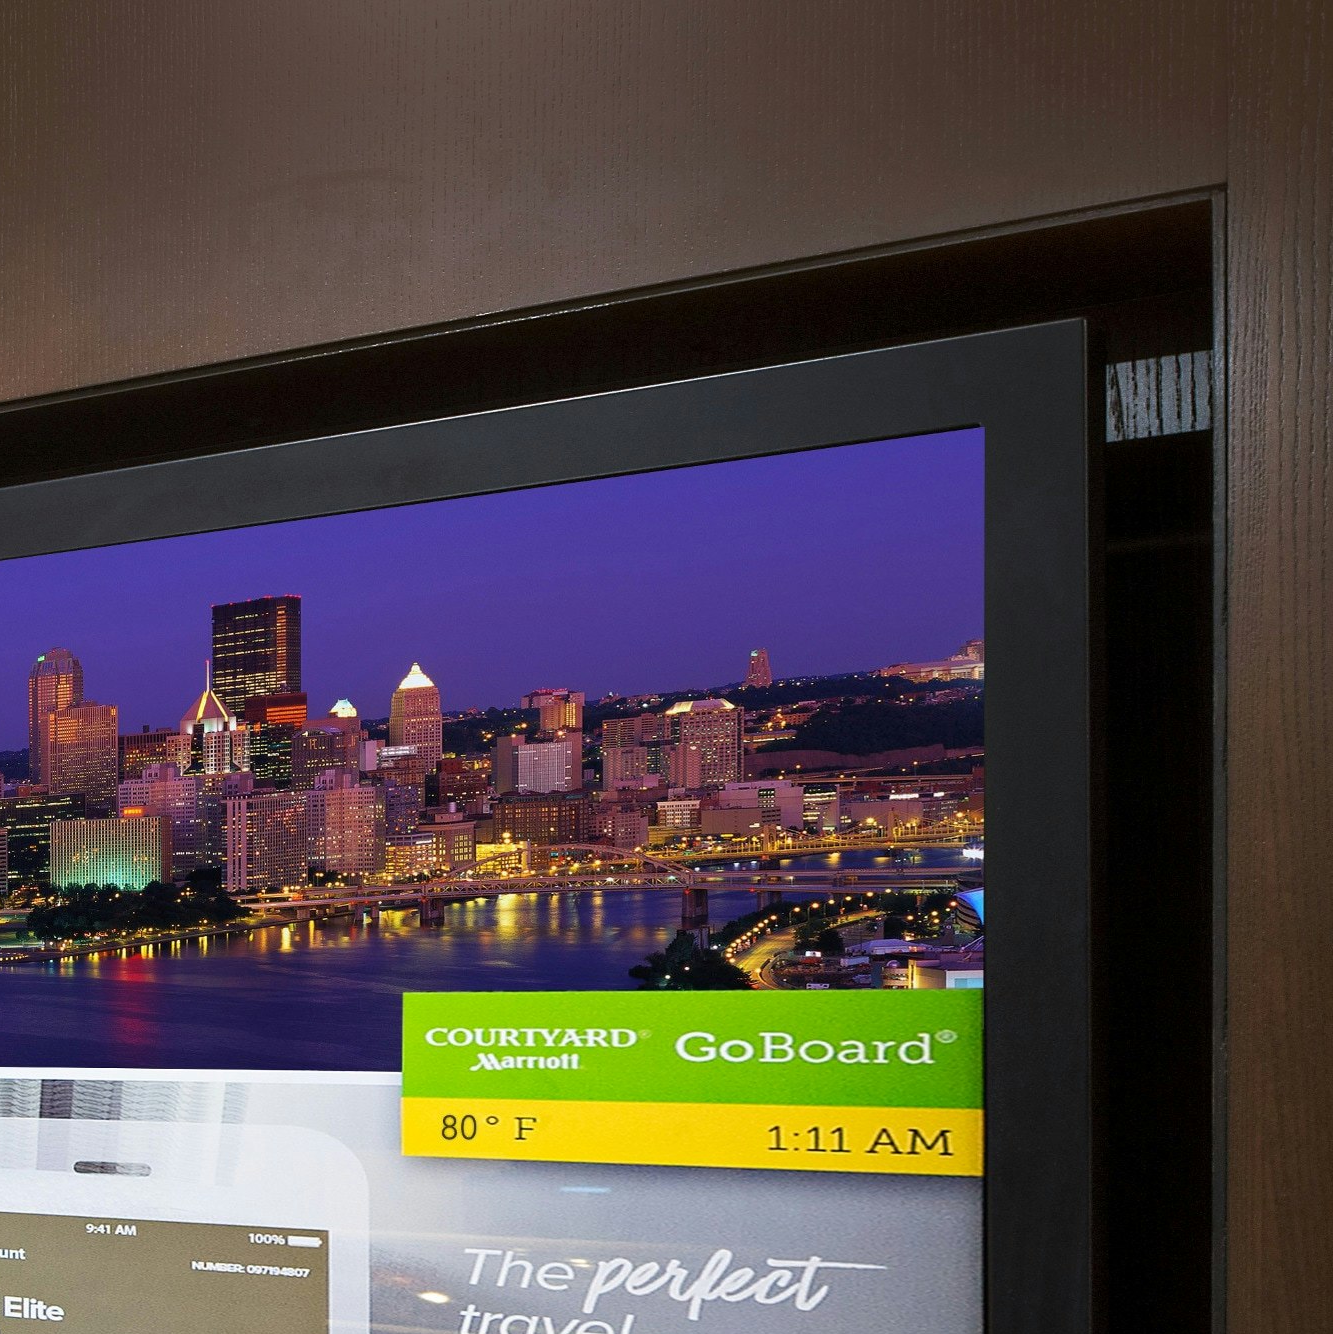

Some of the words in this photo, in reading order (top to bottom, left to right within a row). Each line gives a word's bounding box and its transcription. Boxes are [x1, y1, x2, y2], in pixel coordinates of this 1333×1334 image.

[470, 1053, 579, 1071] Marriott
[514, 1117, 537, 1140] F
[767, 1125, 851, 1153] 1:11
[865, 1128, 954, 1156] AM
[86, 1224, 111, 1235] 9:41
[115, 1225, 137, 1236] AM
[248, 1233, 285, 1245] 100%
[192, 1261, 245, 1273] NUMBER:
[464, 1248, 575, 1291] The
[582, 1248, 888, 1321] perfect
[3, 1296, 65, 1322] Elite
